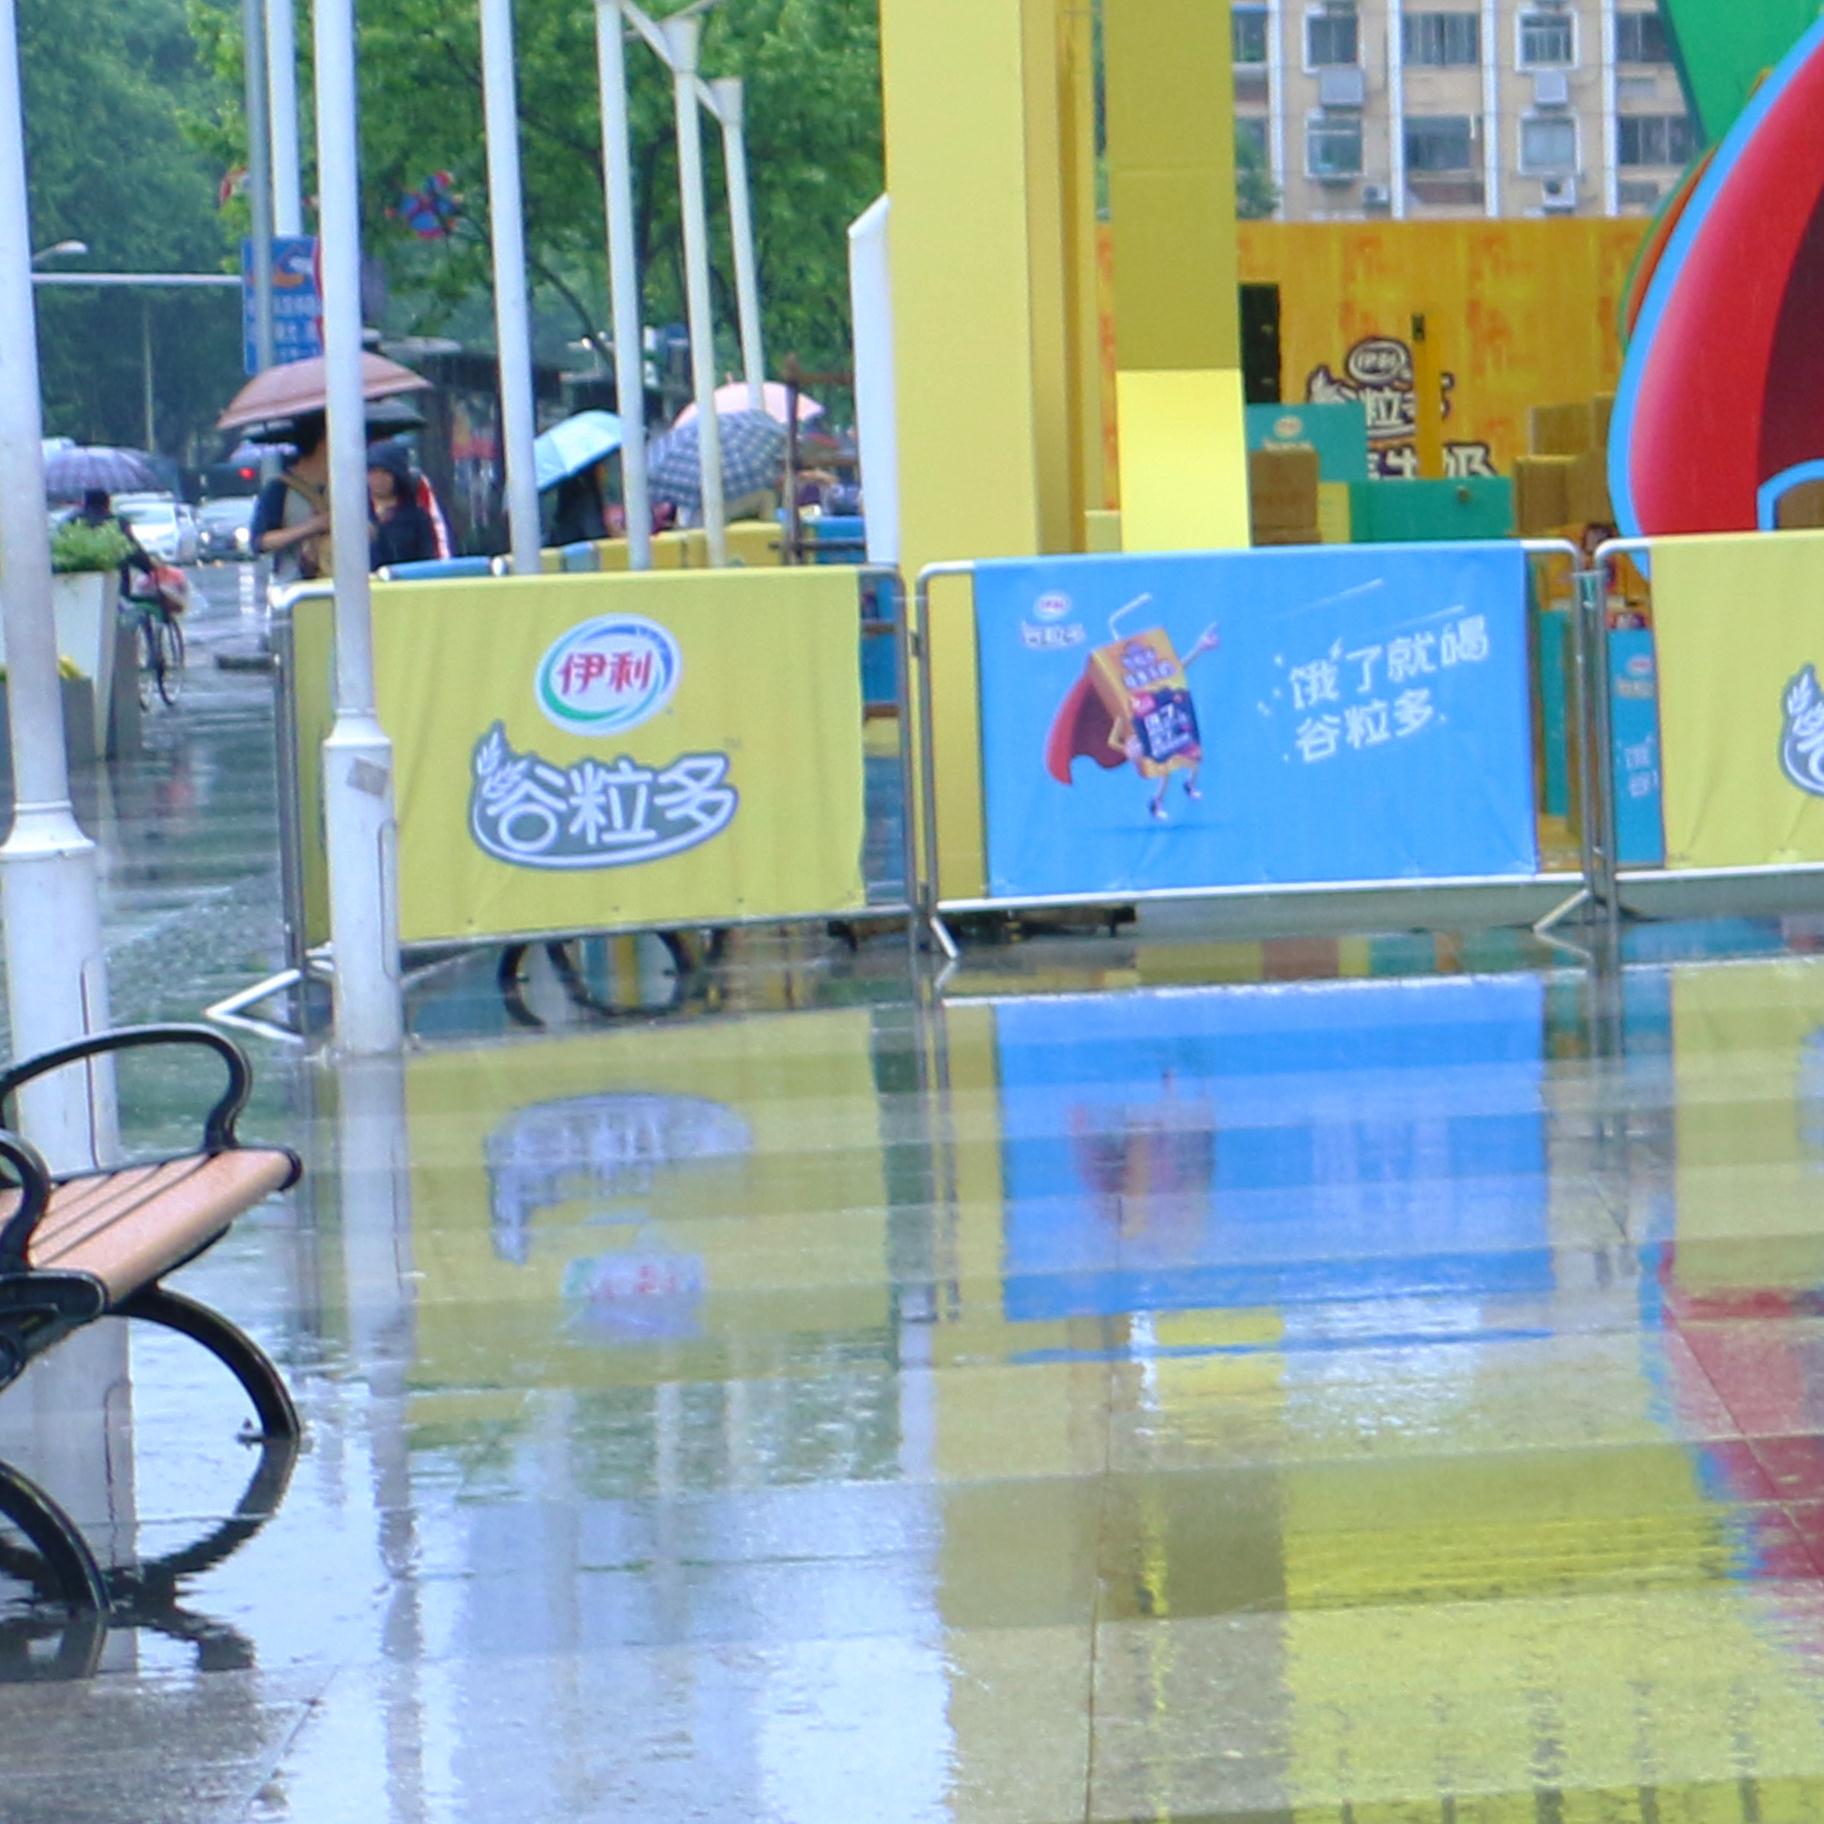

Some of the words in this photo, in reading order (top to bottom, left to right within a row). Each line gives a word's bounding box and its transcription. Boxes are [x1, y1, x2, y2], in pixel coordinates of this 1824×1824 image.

[556, 651, 654, 695] 伊利
[1290, 615, 1489, 709] 饿了就喝
[1297, 688, 1434, 764] 谷粒多
[476, 746, 738, 860] 谷粒多
